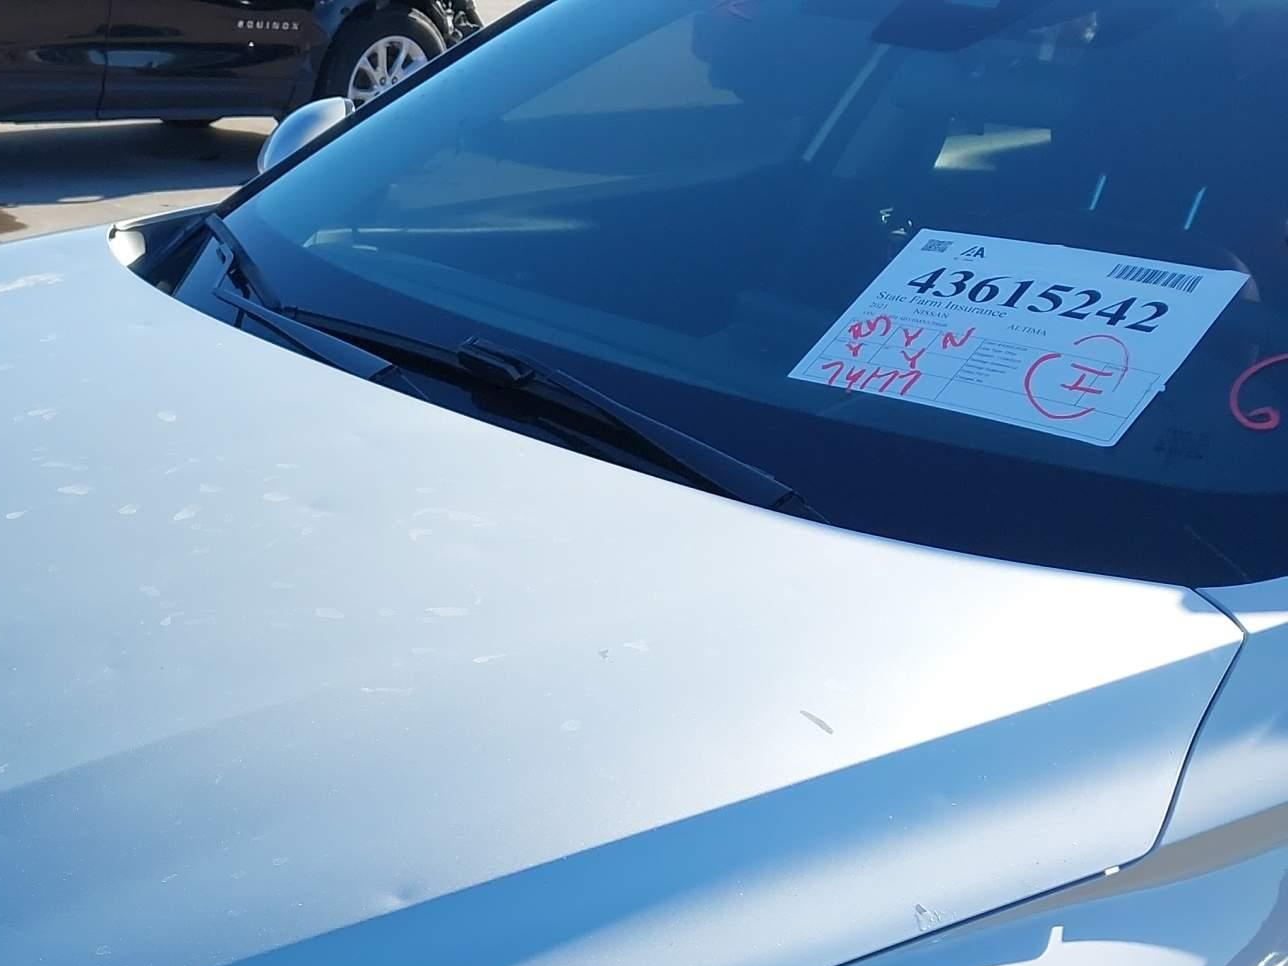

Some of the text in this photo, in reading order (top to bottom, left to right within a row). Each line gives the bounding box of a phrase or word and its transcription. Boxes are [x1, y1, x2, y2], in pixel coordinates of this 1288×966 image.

[237, 20, 299, 30] EQUINOX
[876, 291, 908, 303] State
[910, 296, 943, 311] Farm
[945, 301, 1008, 319] Insurance
[907, 267, 1169, 334] 43615242
[912, 308, 951, 319] NISSAN
[1007, 324, 1048, 337] ALTIMA
